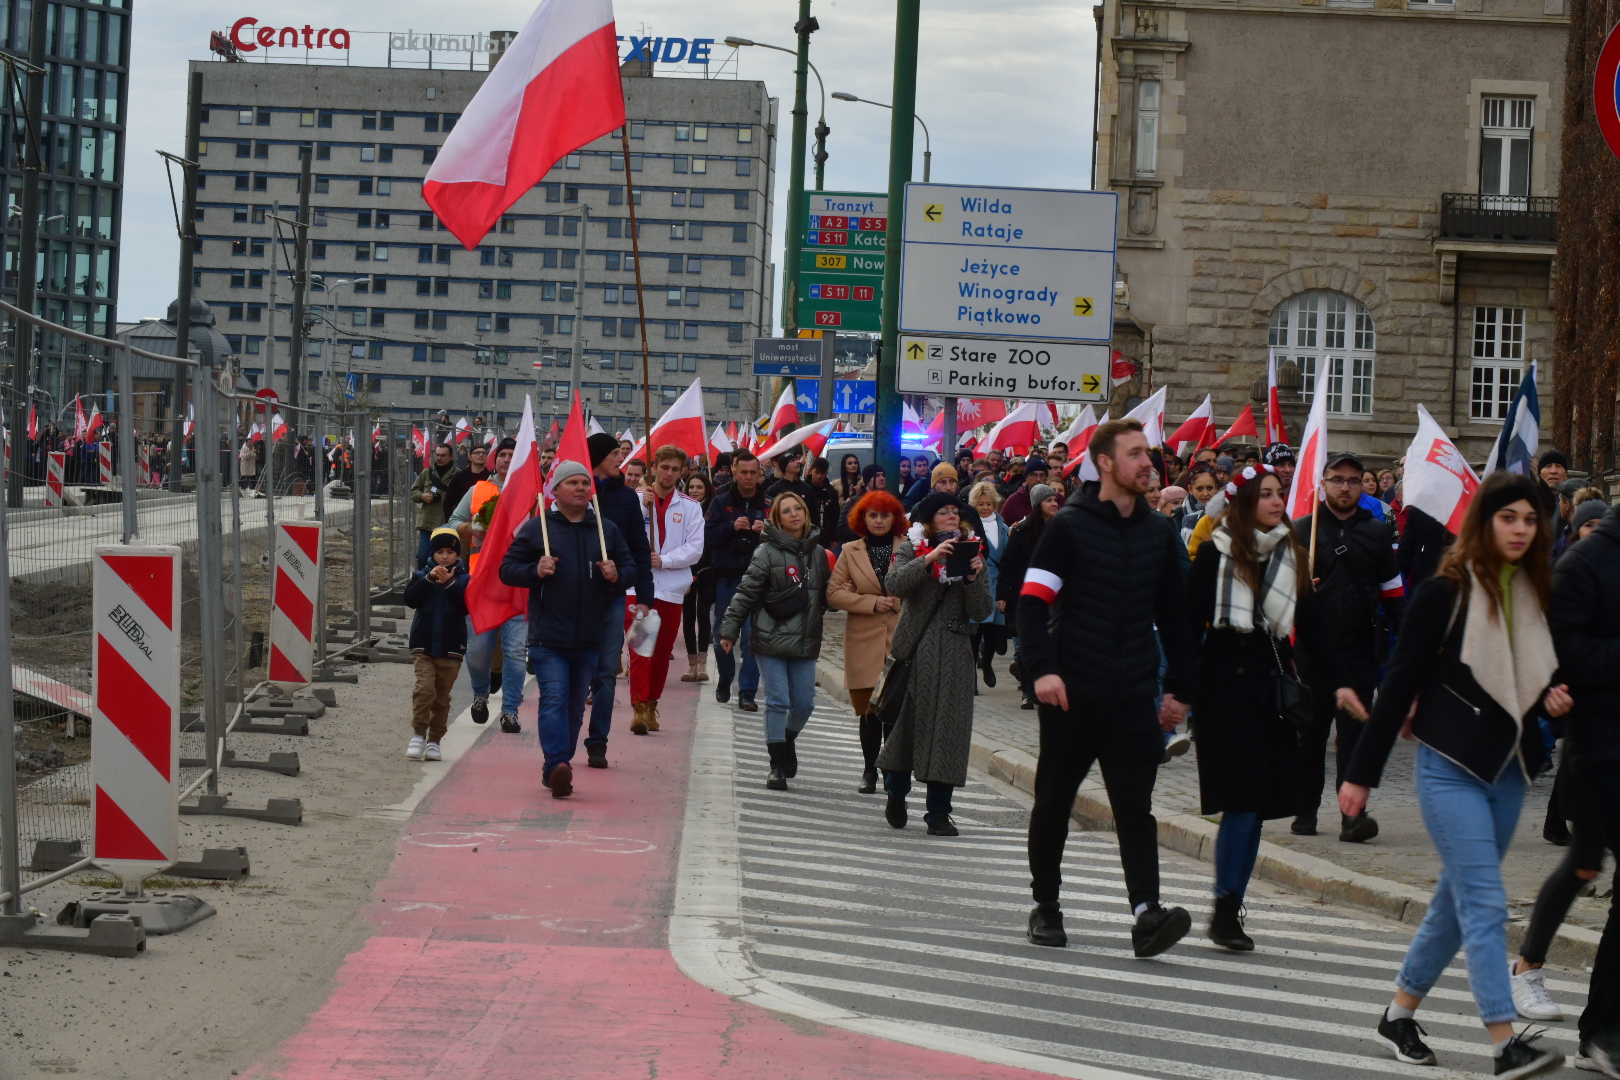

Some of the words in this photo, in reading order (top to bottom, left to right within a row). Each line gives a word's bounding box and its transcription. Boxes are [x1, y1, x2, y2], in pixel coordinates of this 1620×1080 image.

[230, 17, 350, 52] Centra
[824, 199, 874, 215] Tranzyt
[961, 197, 1012, 214] Wilda
[826, 218, 833, 227] A
[836, 218, 842, 227] 2
[865, 219, 871, 229] S
[875, 220, 882, 229] 5
[824, 233, 831, 243] S
[834, 234, 842, 243] 11
[962, 221, 1023, 243] Rataje
[821, 256, 841, 267] 307
[960, 258, 1020, 279] Jeżyce
[826, 287, 833, 297] S
[836, 287, 845, 297] 11
[859, 288, 868, 299] 11
[958, 282, 1058, 306] Winogrady
[821, 313, 835, 324] 92
[957, 305, 1041, 326] Piątkowo
[778, 343, 799, 351] most
[759, 353, 817, 364] Uniwersytecki
[949, 345, 997, 364] Stare
[1008, 348, 1051, 366] ZOO
[948, 370, 1017, 392] Parking
[1028, 374, 1081, 393] bufor.
